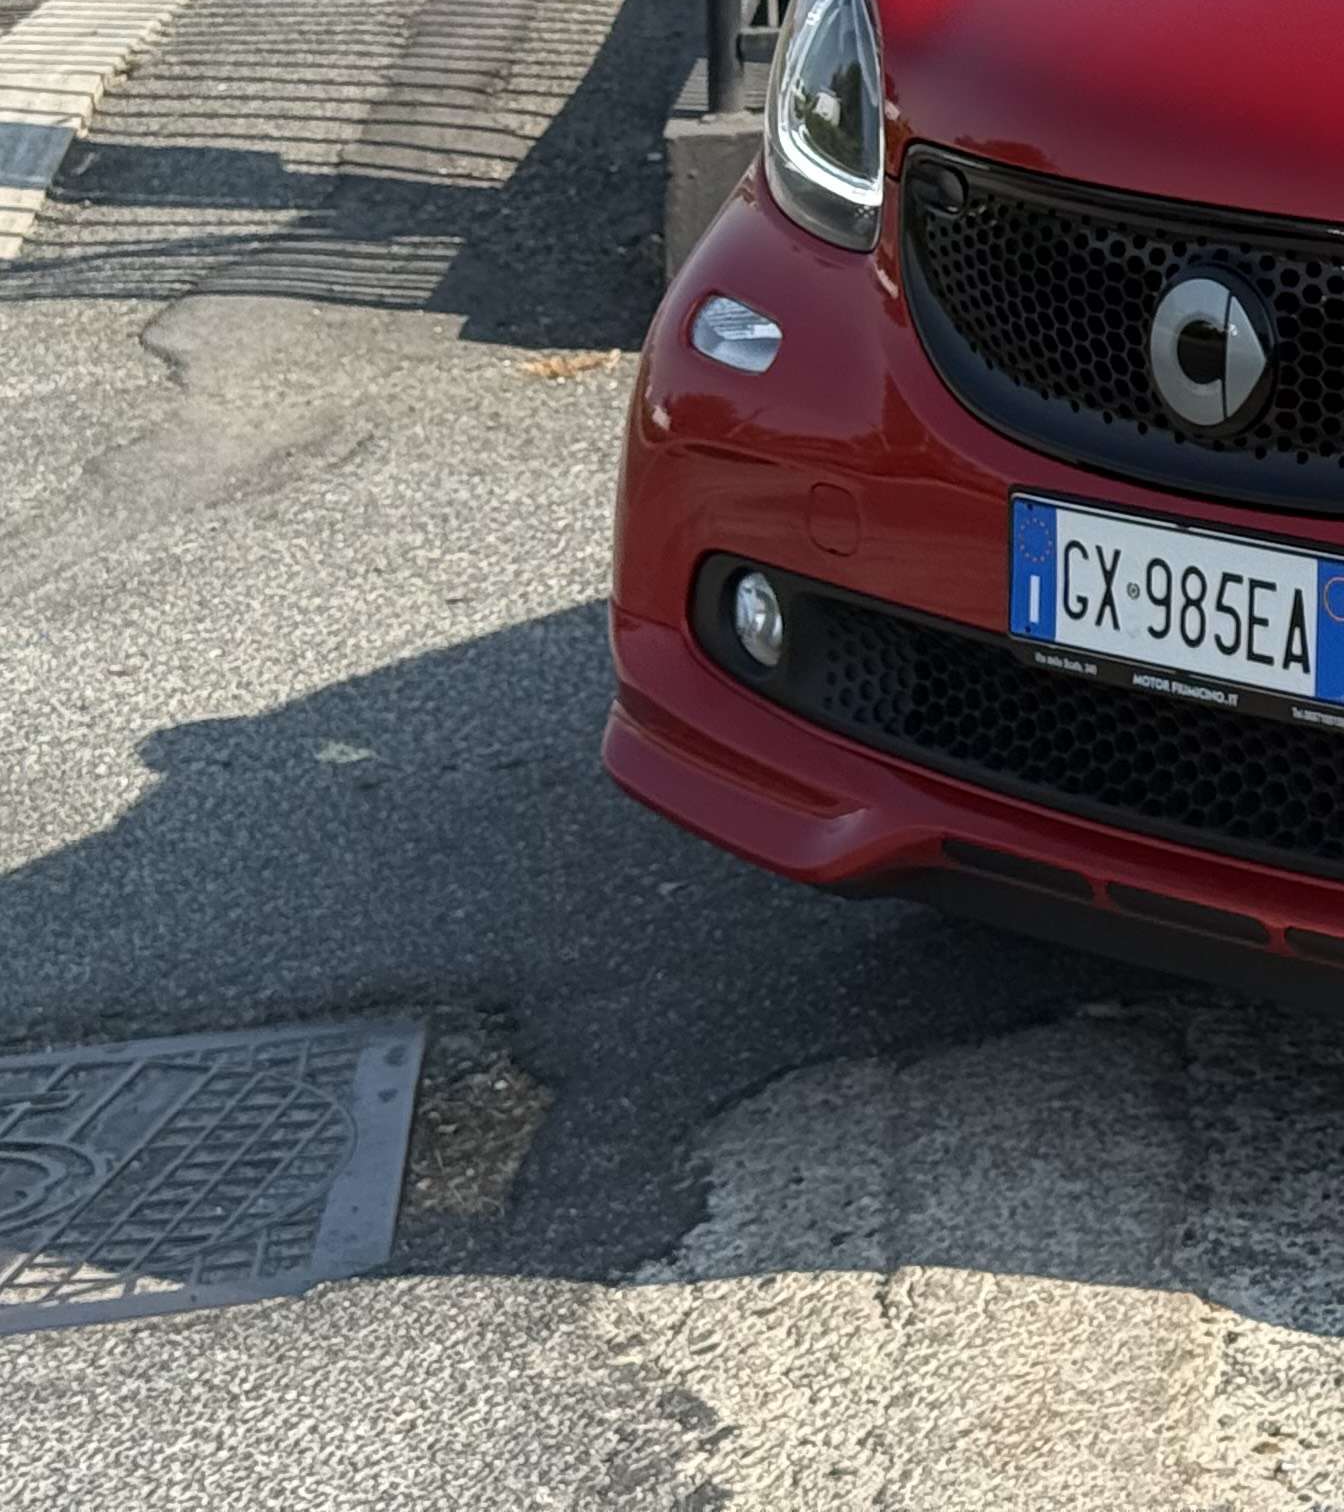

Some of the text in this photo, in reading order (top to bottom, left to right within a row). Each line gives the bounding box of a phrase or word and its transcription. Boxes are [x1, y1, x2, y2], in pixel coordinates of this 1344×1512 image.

[1062, 539, 1312, 675] GX 985EA
[1132, 673, 1171, 692] MOTOR
